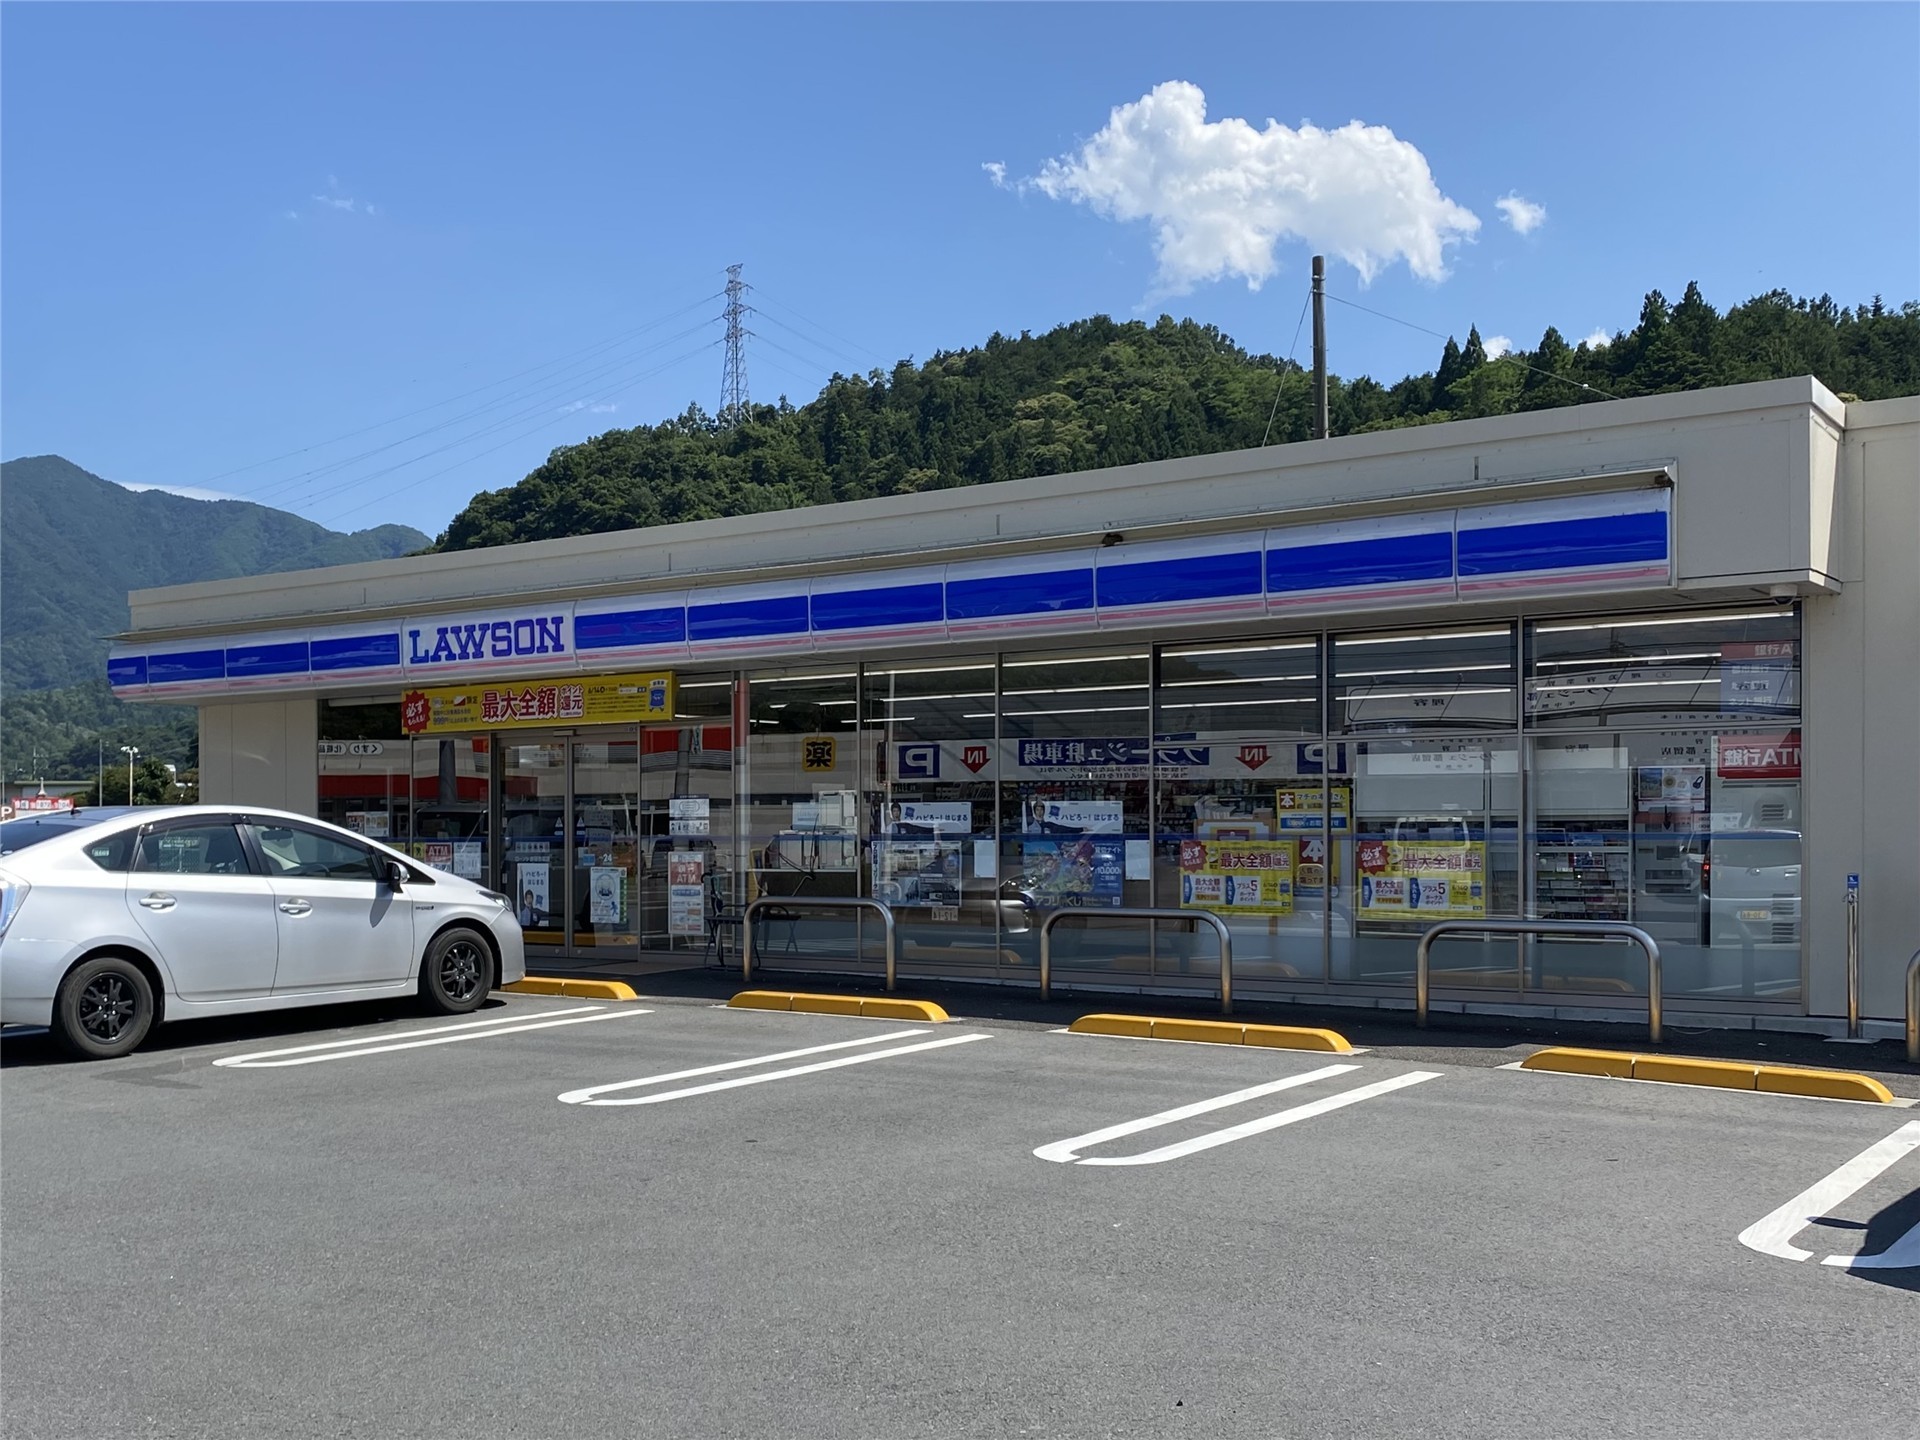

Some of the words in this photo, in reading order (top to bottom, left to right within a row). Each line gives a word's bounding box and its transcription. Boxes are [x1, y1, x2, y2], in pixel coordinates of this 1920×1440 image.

[409, 616, 565, 664] LAWSON
[562, 685, 583, 695] ポイント
[406, 700, 424, 718] 必ず
[482, 689, 558, 720] 最大全額
[561, 695, 583, 711] 還元
[945, 814, 968, 822] はじまる
[1093, 814, 1119, 822] はじまる
[429, 847, 448, 856] ATM
[1184, 846, 1201, 860] 必ず
[1361, 846, 1382, 861] 必ず
[1221, 853, 1272, 869] 最大全額
[1404, 853, 1462, 870] 最大全額
